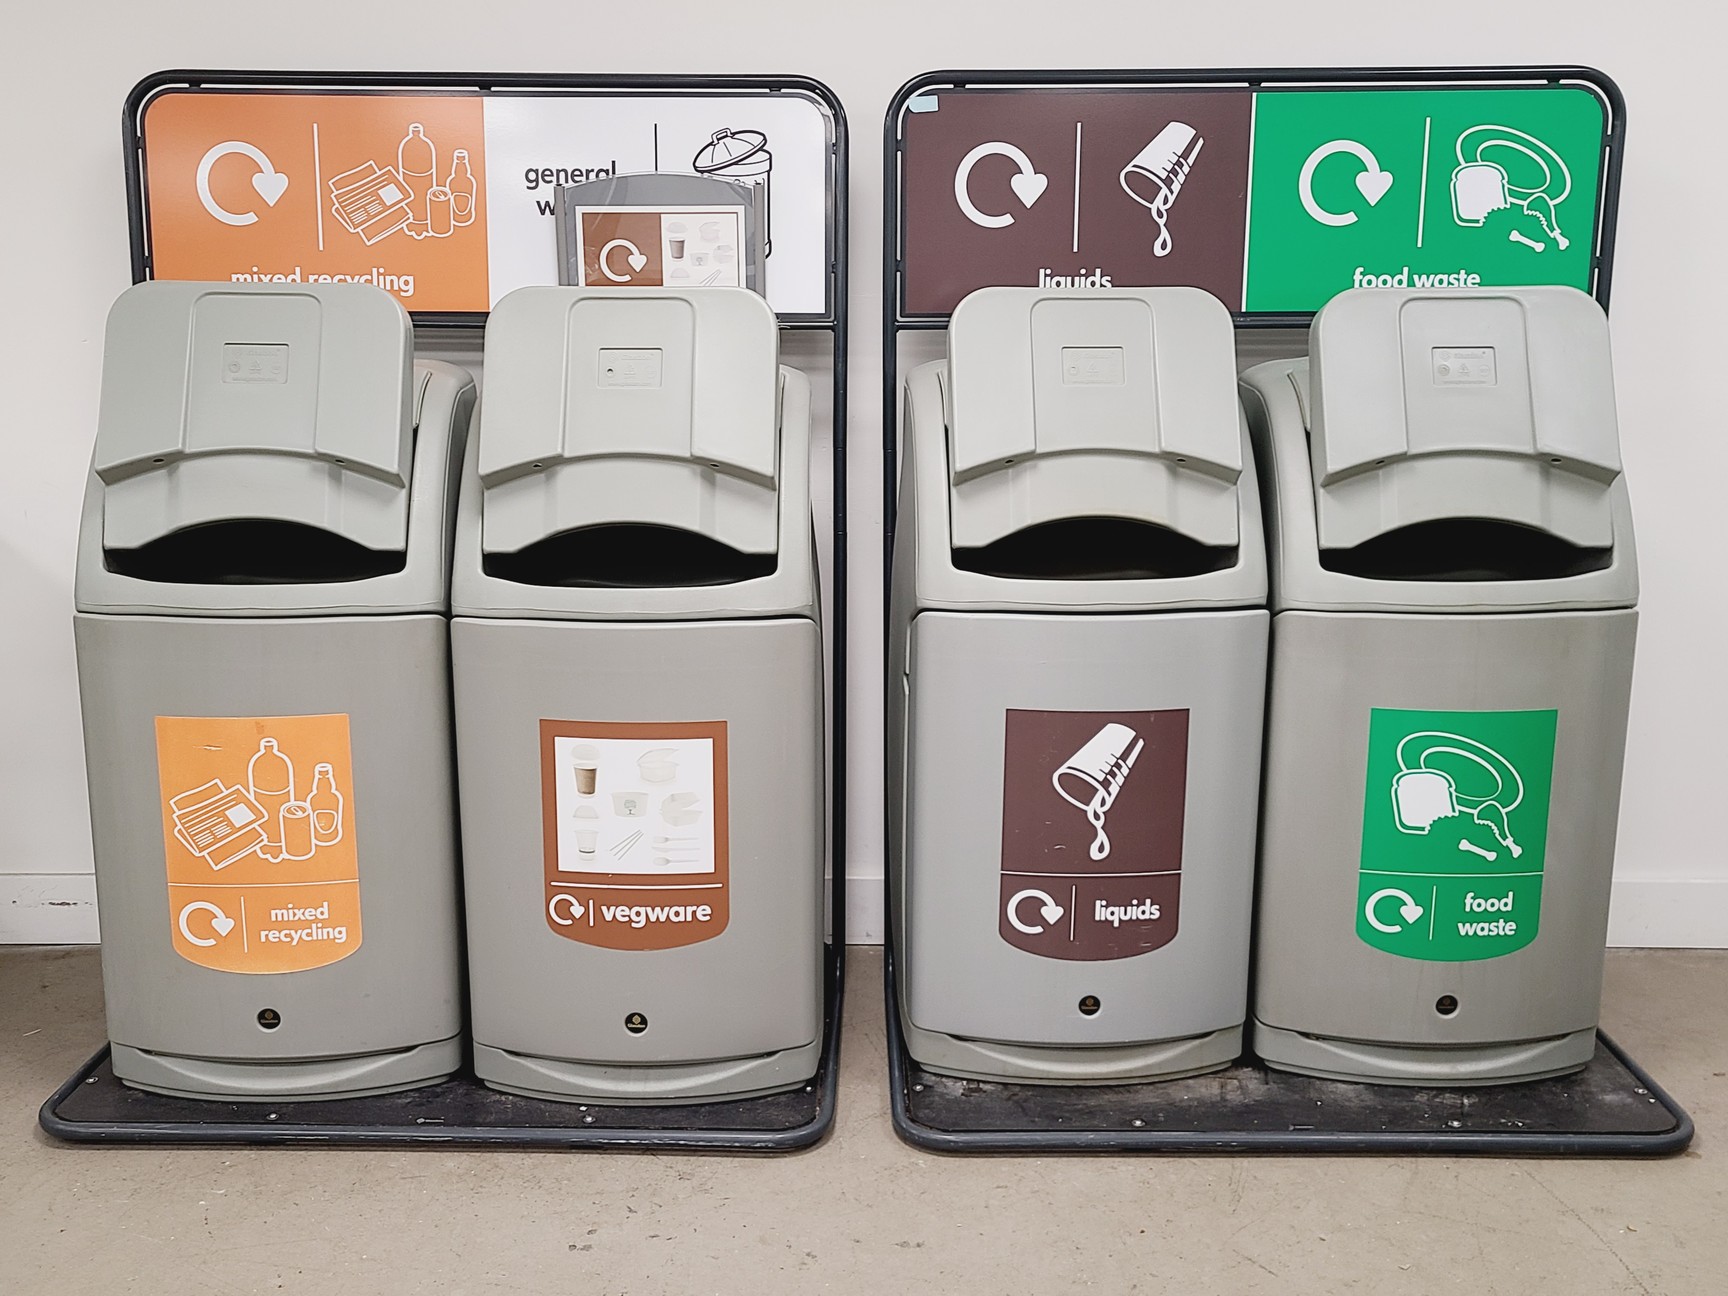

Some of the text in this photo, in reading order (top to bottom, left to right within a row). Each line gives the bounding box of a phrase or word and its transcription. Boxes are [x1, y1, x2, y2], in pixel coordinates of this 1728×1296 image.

[524, 160, 616, 190] general
[231, 266, 301, 283] mixed
[1039, 268, 1112, 288] liquids
[1353, 266, 1481, 288] food waste
[270, 901, 329, 921] mixed
[1464, 891, 1514, 912] food
[600, 904, 712, 928] vegware
[1094, 898, 1161, 928] liquids
[260, 922, 347, 946] recycling
[1457, 918, 1517, 936] waste
